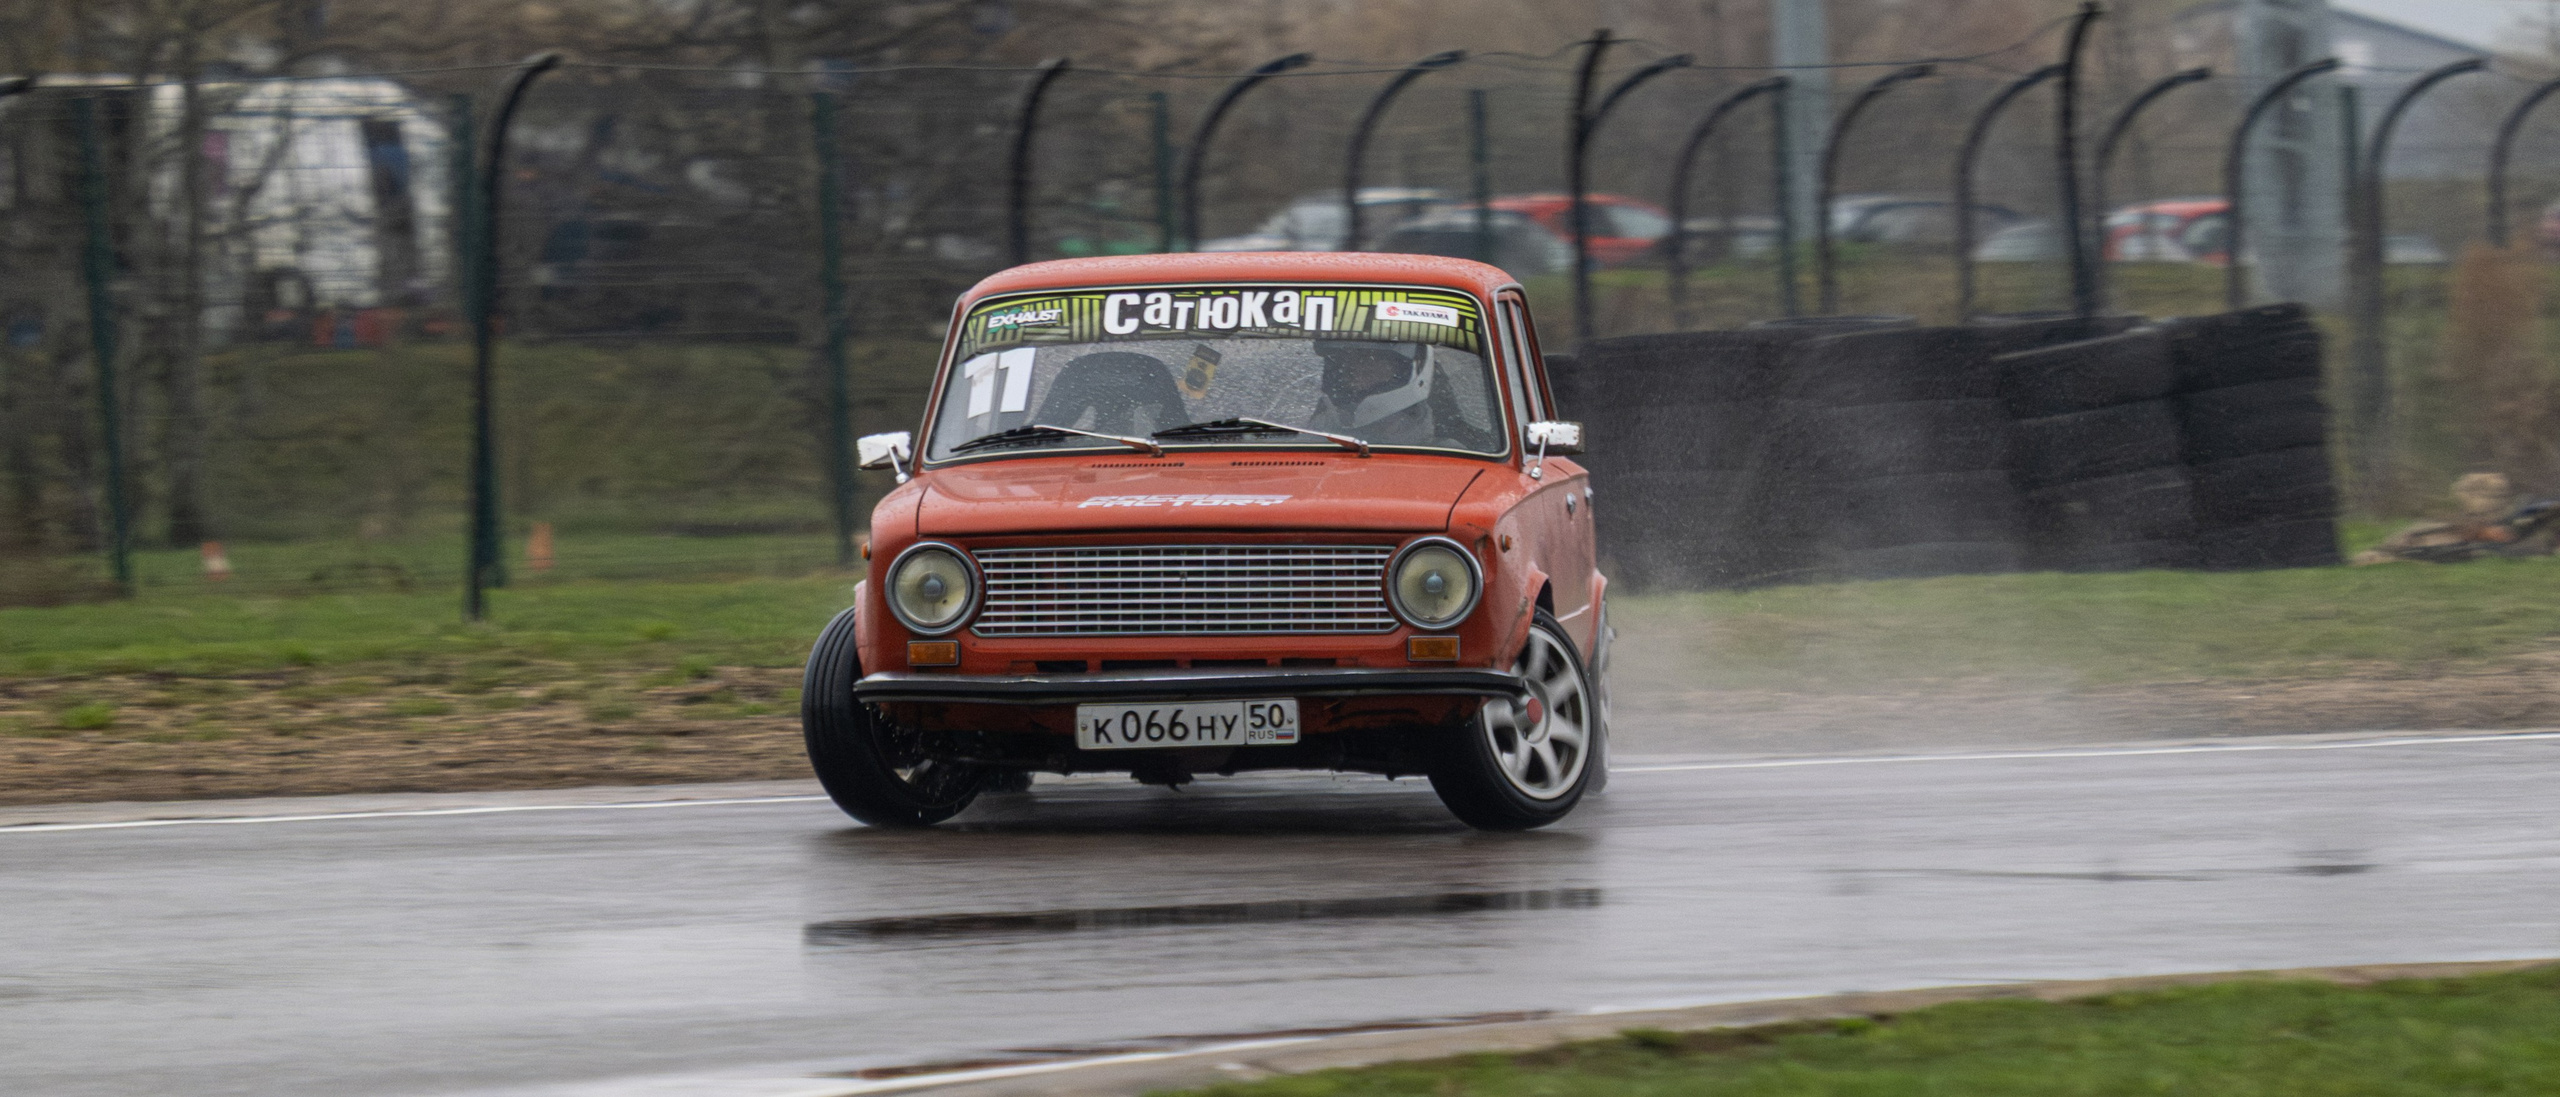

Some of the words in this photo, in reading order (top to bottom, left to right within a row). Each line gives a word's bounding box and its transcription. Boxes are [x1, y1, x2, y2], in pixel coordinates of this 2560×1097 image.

[987, 308, 1063, 329] EXHAUST
[1403, 309, 1449, 321] TAKAYAMA
[964, 347, 1036, 419] 11
[1077, 498, 1287, 509] FACTORY
[1250, 703, 1284, 729] 50
[1249, 729, 1275, 740] RUS
